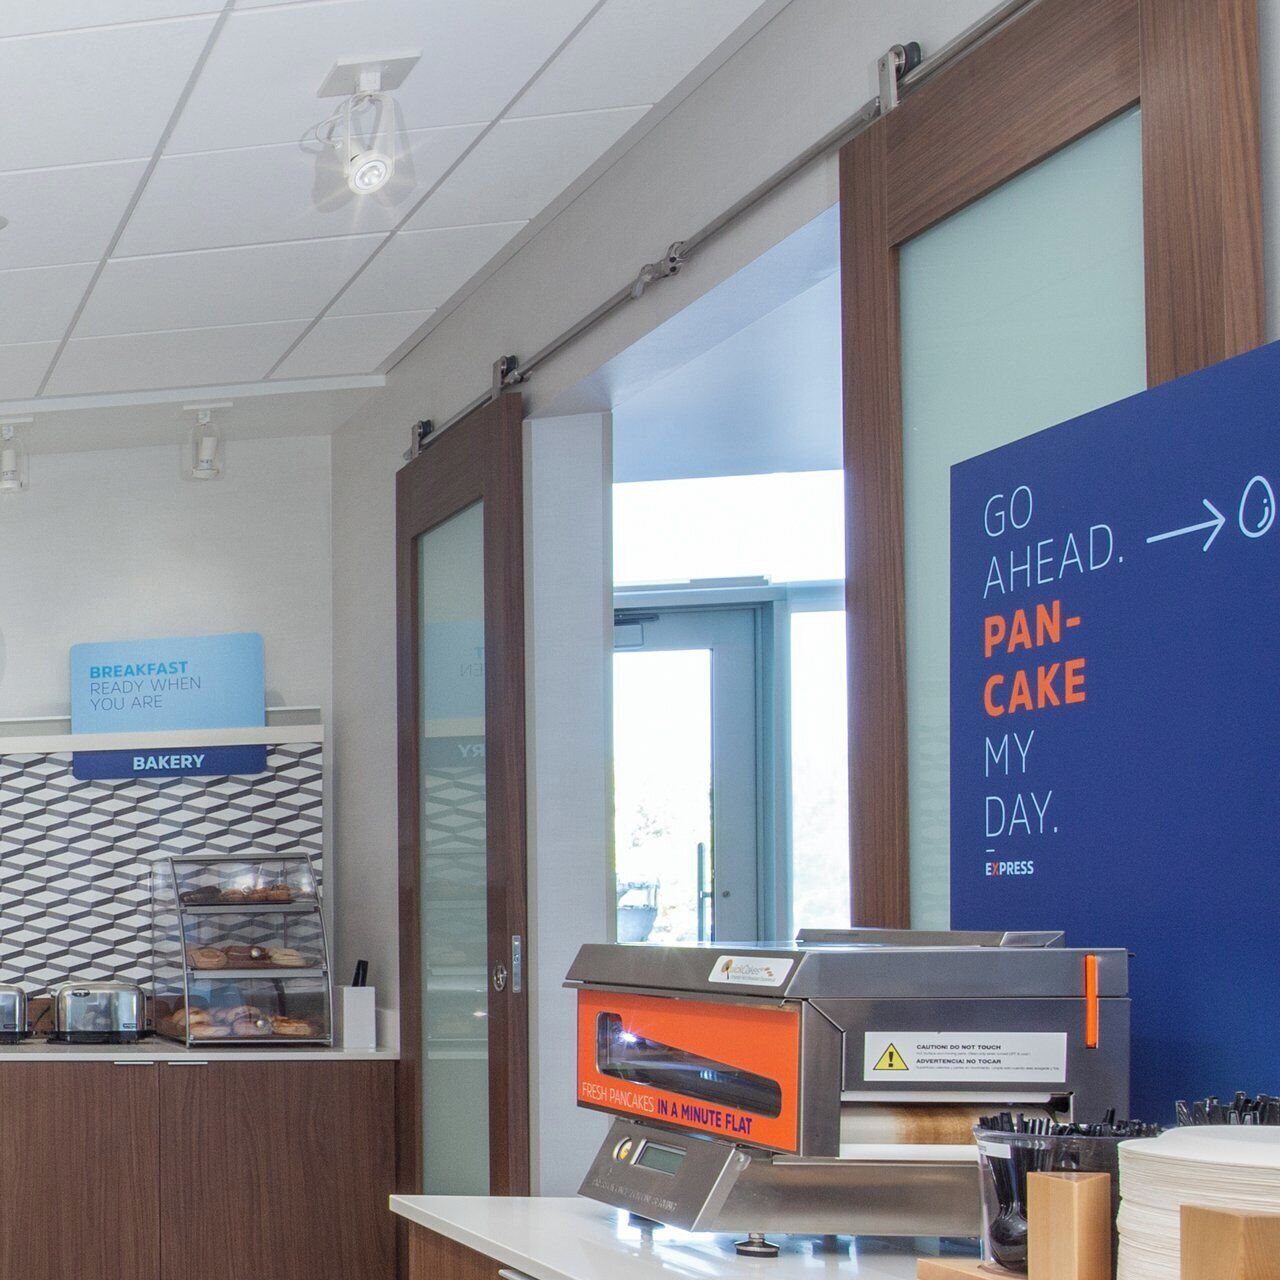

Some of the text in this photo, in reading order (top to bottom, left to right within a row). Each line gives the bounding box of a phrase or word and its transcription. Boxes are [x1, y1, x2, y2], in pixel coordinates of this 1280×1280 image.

[983, 485, 1034, 538] GO
[983, 524, 1123, 599] AHEAD.
[984, 600, 1081, 658] PAN-
[90, 661, 188, 679] BREAKFAST
[90, 677, 201, 695] READY WHEN
[984, 658, 1086, 717] CAKE
[90, 695, 163, 711] YOU ARE
[133, 754, 205, 771] BAKERY
[985, 730, 1034, 777] MY
[985, 790, 1058, 837] DAY.
[985, 860, 1034, 876] EXPRESS
[582, 1082, 753, 1135] FRESH PANCAKES IN A MINUTE FLAT
